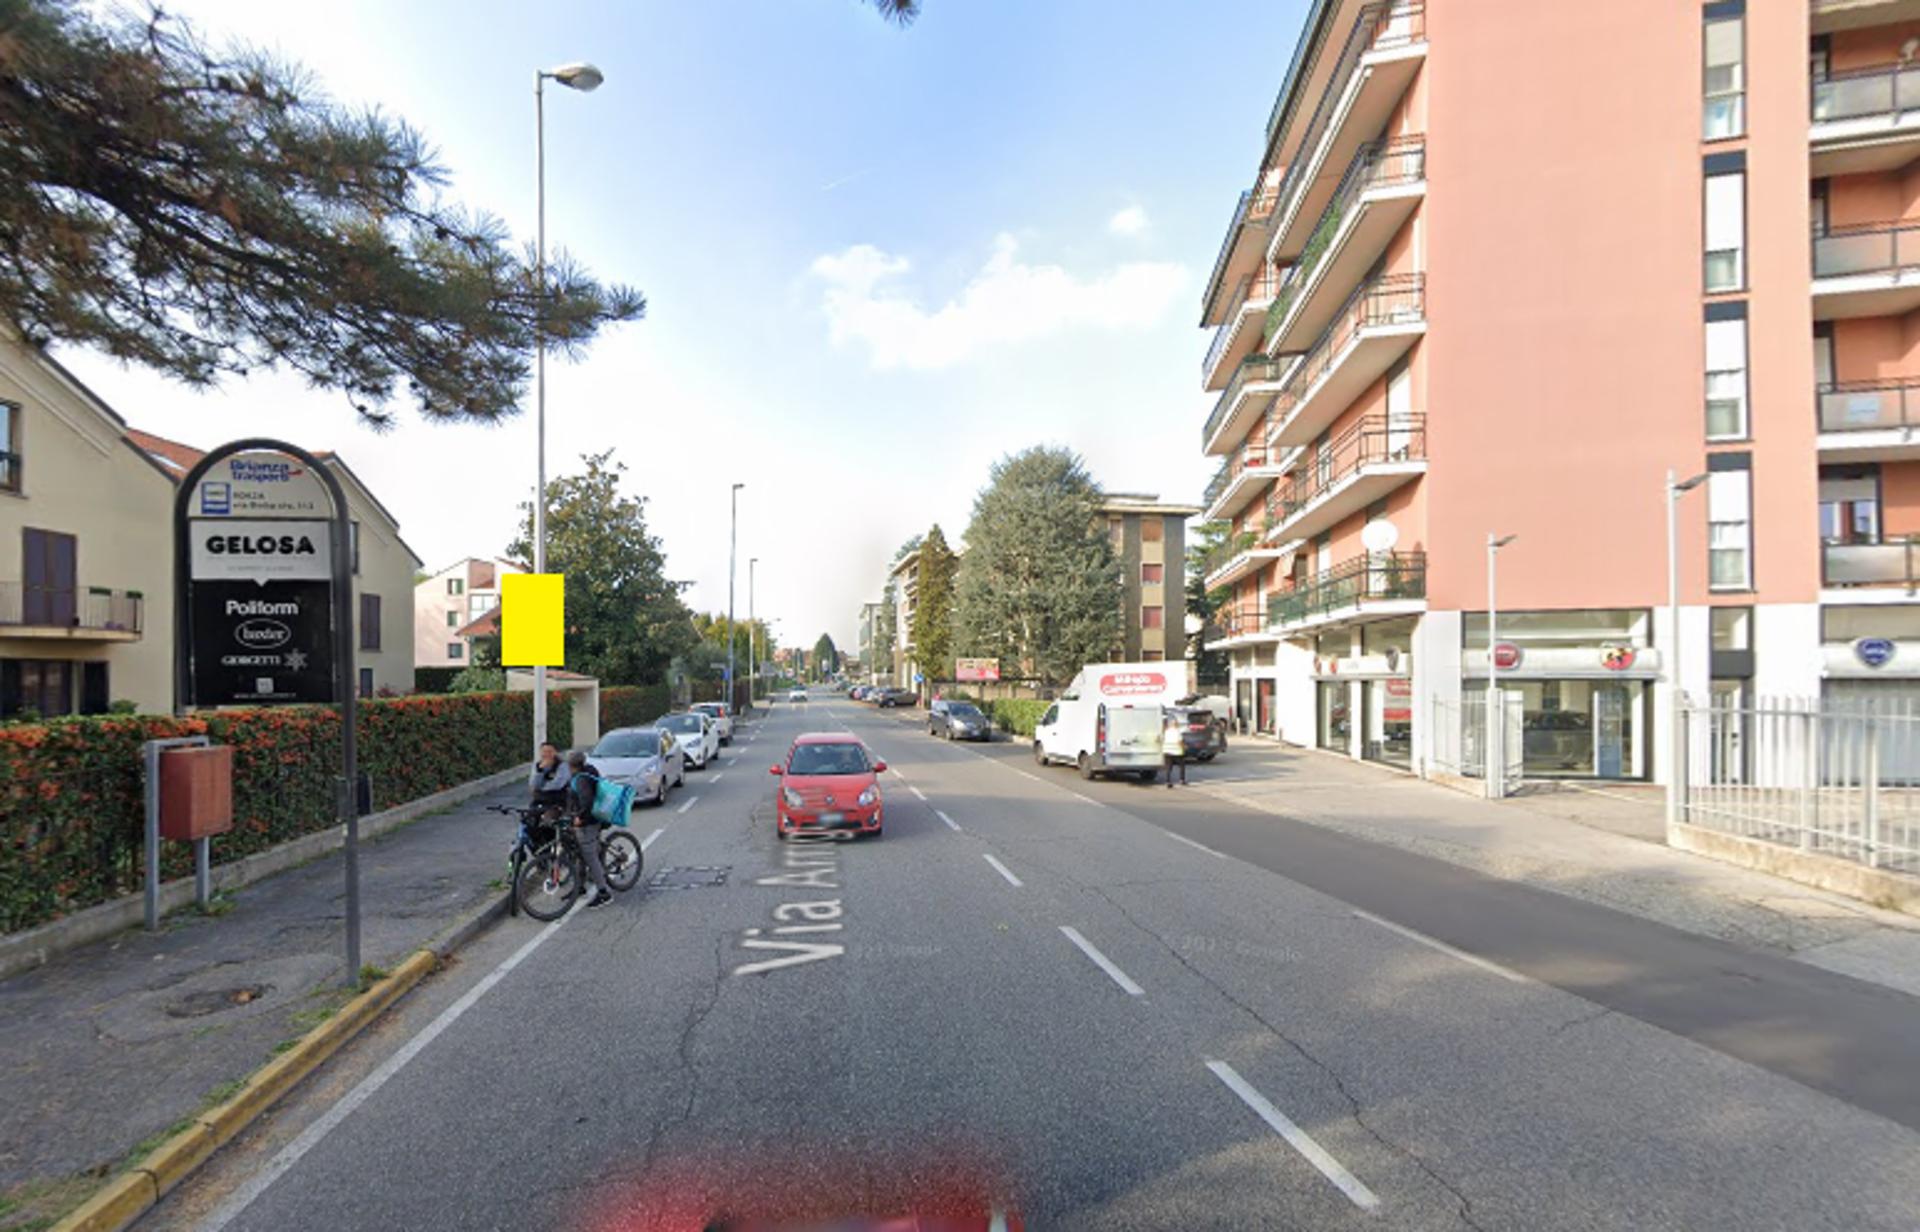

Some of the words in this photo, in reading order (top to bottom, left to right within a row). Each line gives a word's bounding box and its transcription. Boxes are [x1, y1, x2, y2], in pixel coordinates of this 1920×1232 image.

[230, 459, 289, 471] Brianza
[206, 535, 316, 555] GELOSA
[225, 600, 299, 615] Poliform
